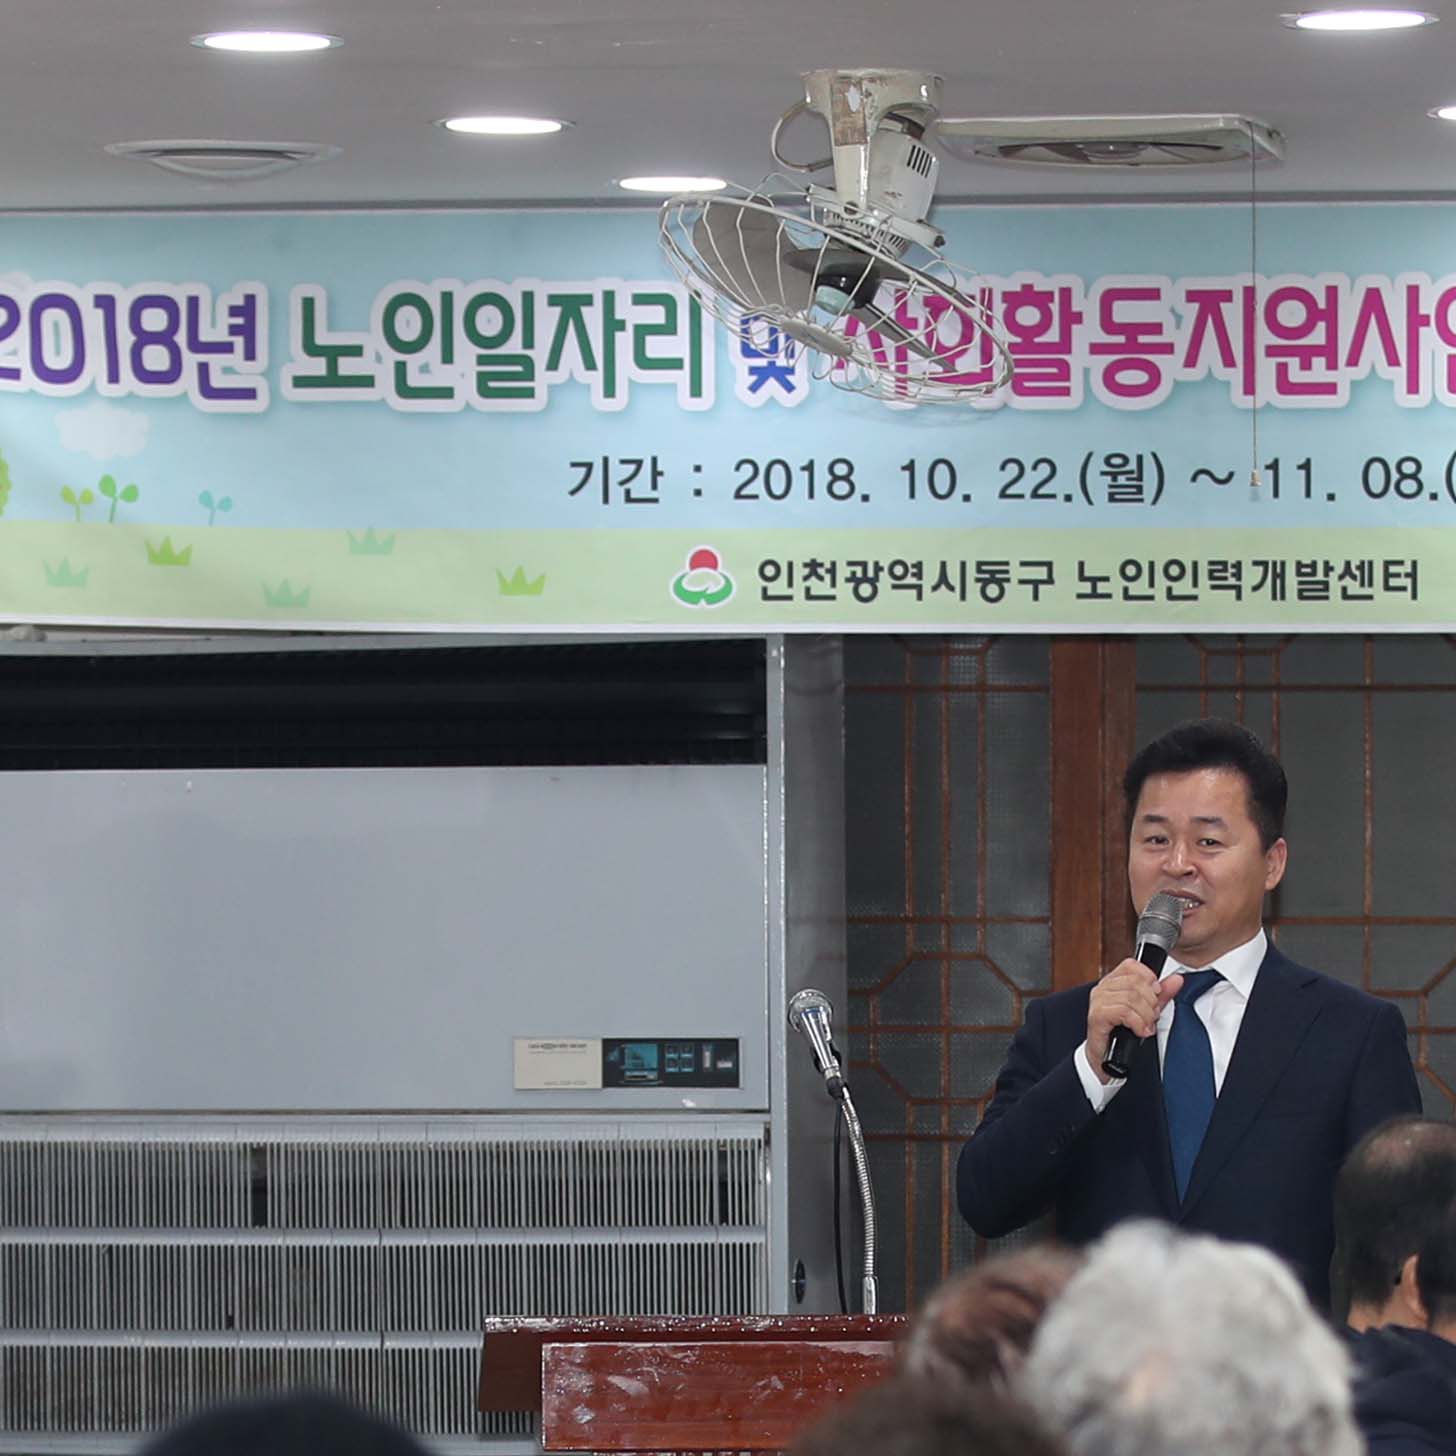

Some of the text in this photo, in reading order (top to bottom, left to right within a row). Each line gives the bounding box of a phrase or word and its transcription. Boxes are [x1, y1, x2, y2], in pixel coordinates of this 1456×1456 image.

[292, 289, 702, 399] 노인일자리
[568, 455, 664, 505] 기간
[733, 457, 871, 502] 2018.
[899, 457, 972, 503] 10.
[997, 450, 1166, 506] 22.(월)
[1263, 456, 1337, 503] 11.
[757, 557, 1419, 604] 인천광역시동구 노인인력개발센터
